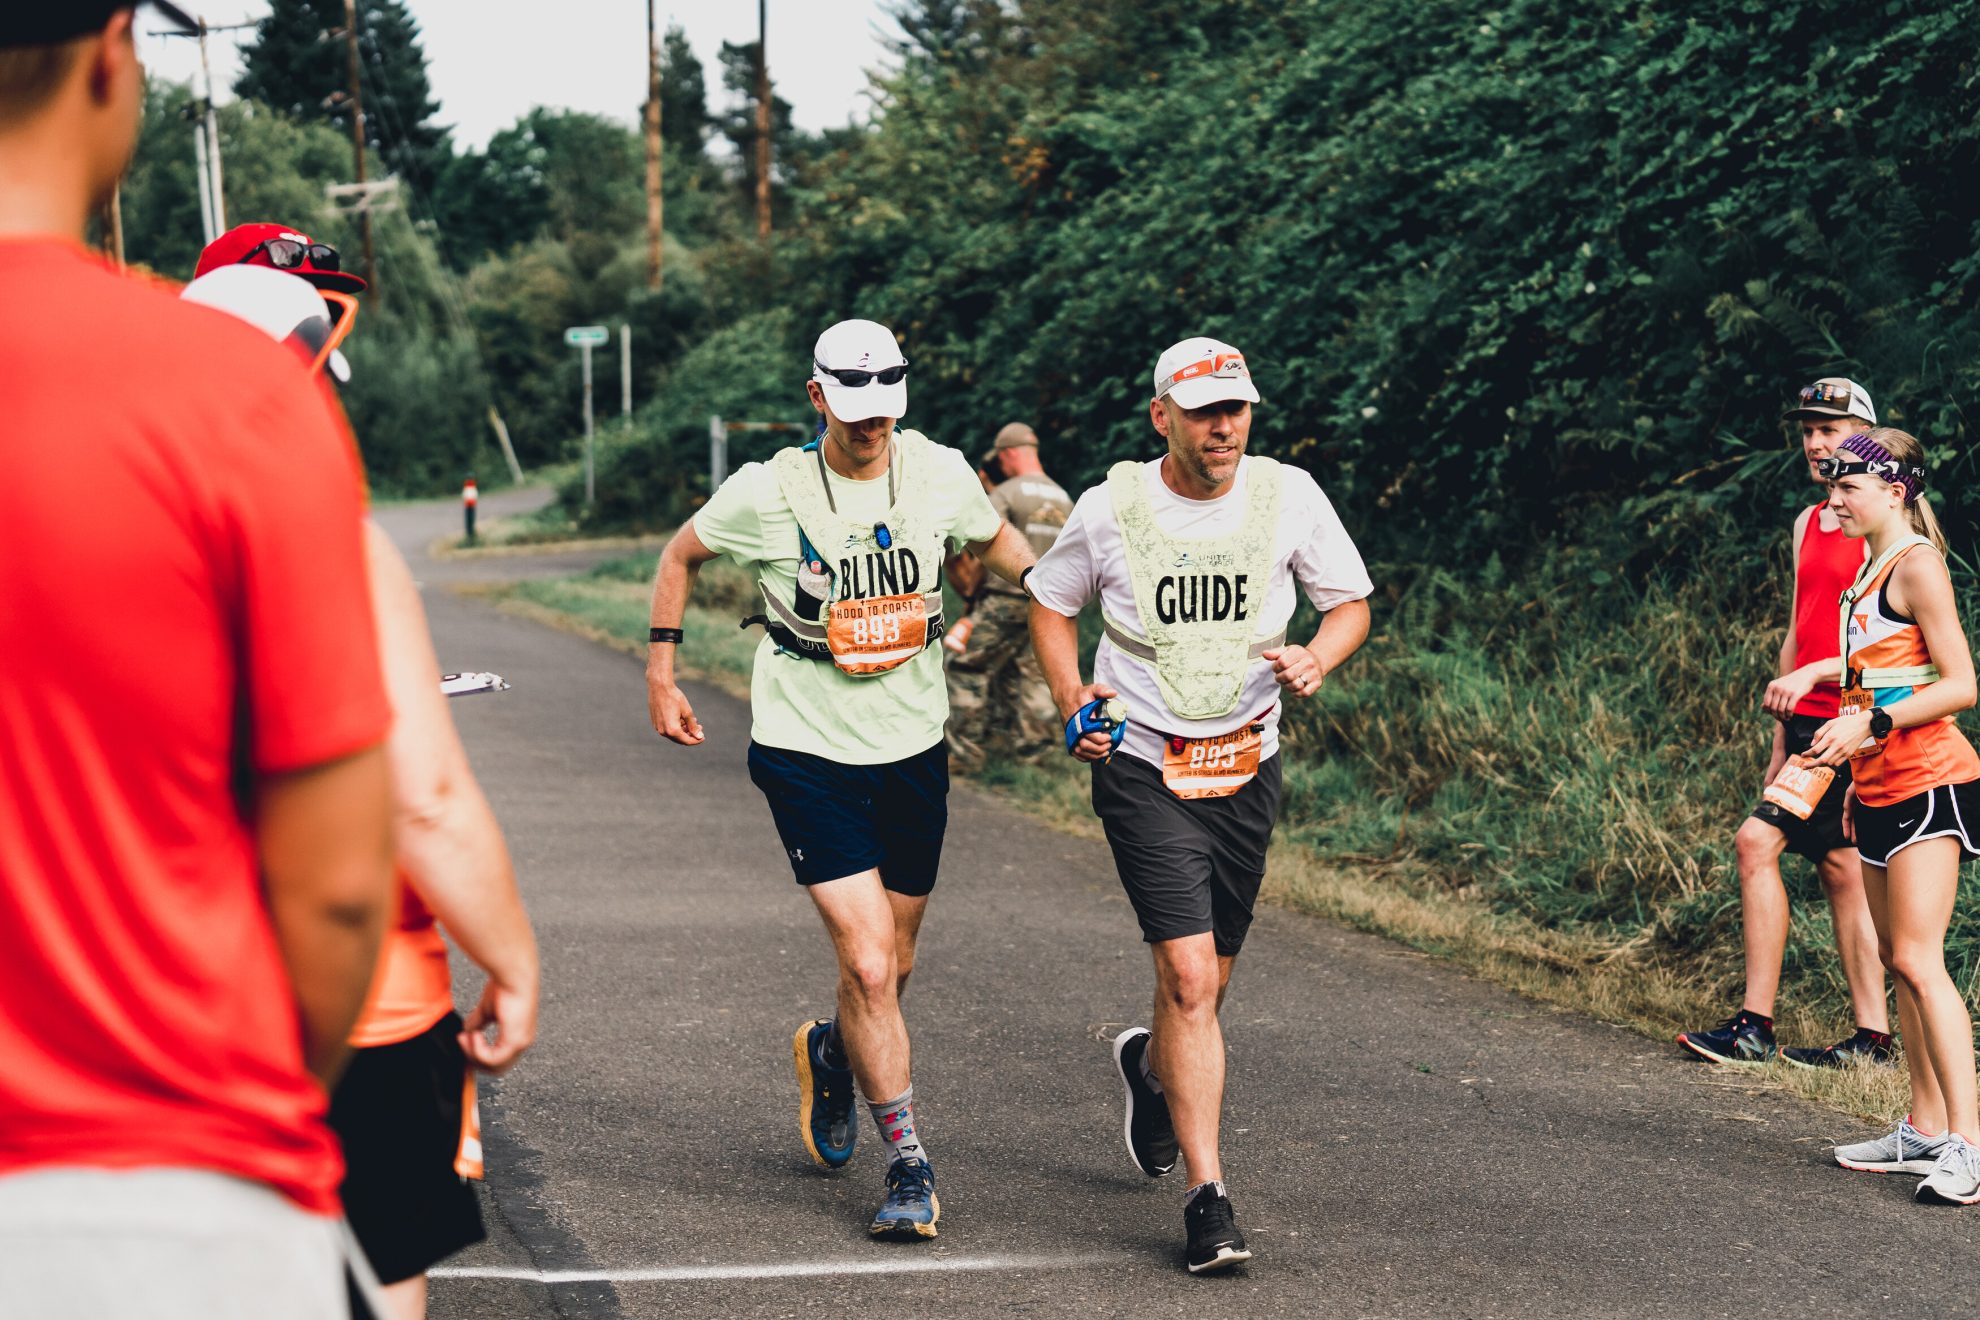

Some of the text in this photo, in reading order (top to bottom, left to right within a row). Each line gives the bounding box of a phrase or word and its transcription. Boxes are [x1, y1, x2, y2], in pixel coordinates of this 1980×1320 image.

[840, 548, 920, 600] BLIND
[837, 607, 863, 619] HOOD
[868, 605, 878, 616] TO
[882, 601, 913, 615] COAST
[1156, 574, 1248, 625] GUIDE
[853, 614, 900, 645] 893
[1848, 694, 1867, 705] COAST
[1223, 730, 1249, 745] COAST
[1189, 743, 1236, 769] 893
